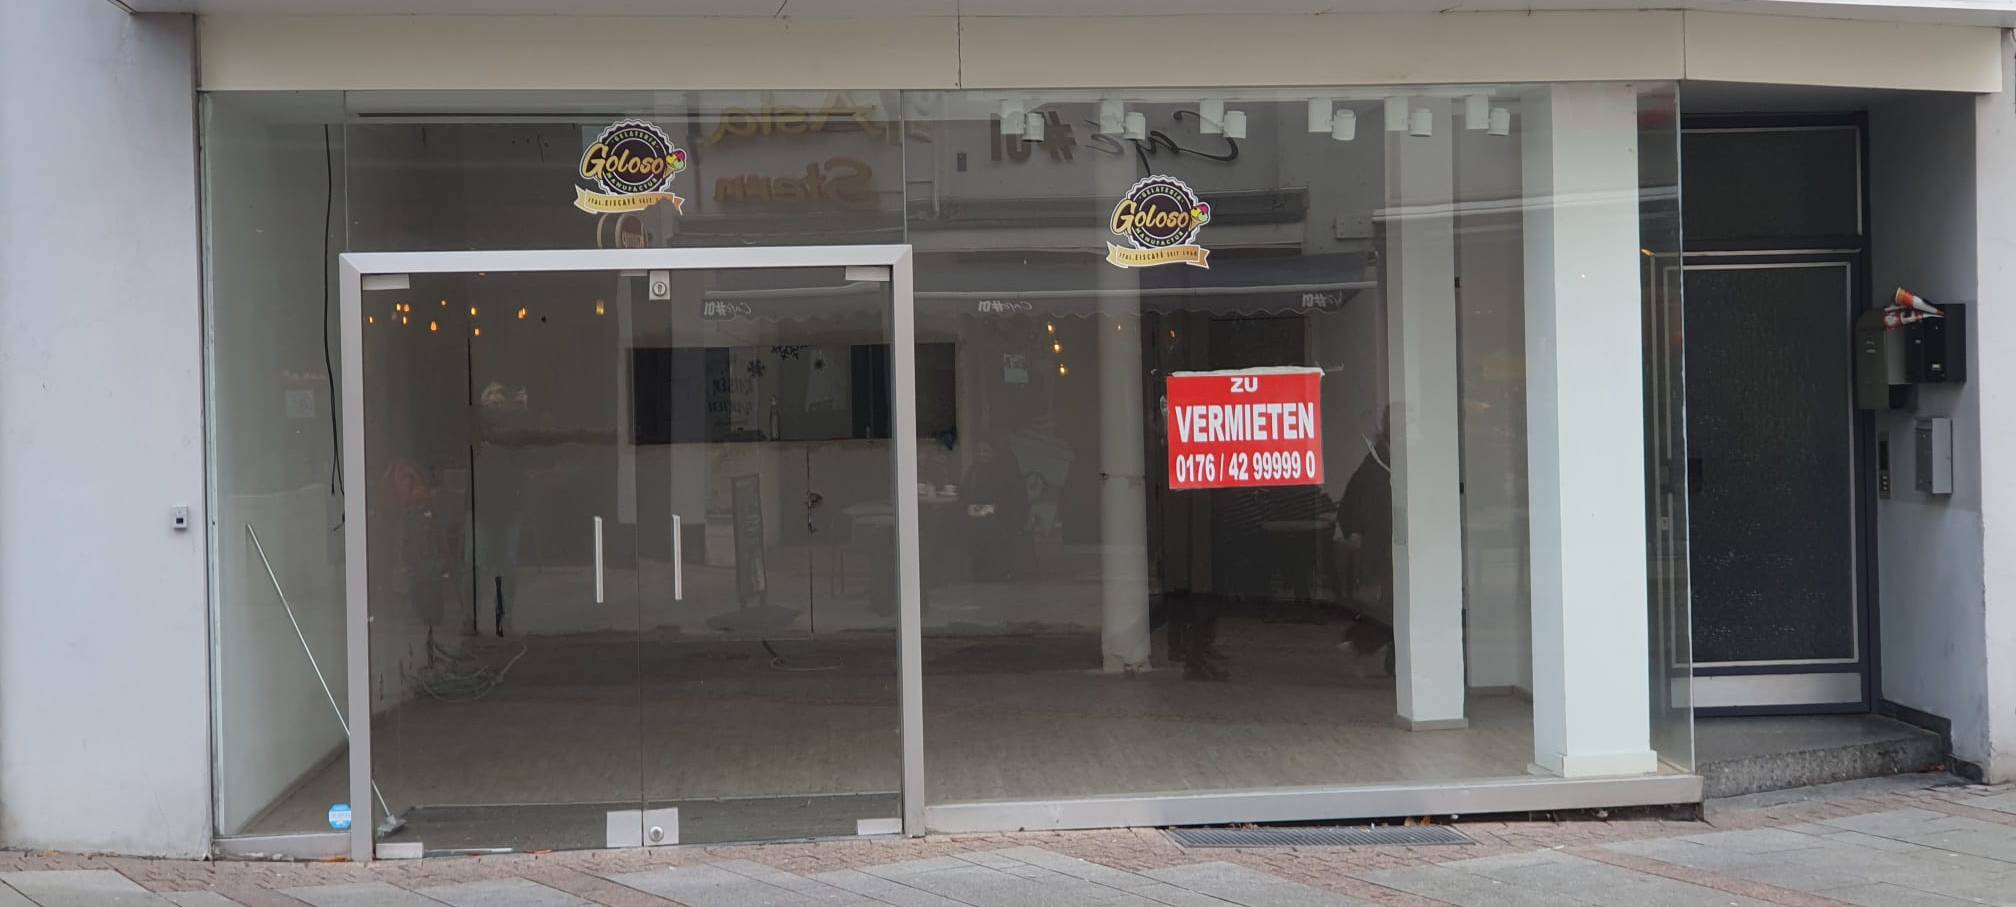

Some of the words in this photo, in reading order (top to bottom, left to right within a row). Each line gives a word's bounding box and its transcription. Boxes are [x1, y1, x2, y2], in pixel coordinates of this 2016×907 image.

[614, 130, 657, 147] GELATERIA
[582, 143, 664, 178] Goloso
[1141, 186, 1182, 201] GELATERIA
[1112, 199, 1189, 234] Goloso
[1230, 376, 1258, 393] ZU
[1175, 402, 1314, 443] VERMIETEN
[1176, 452, 1216, 482] 0176
[1219, 452, 1225, 482] /
[1228, 452, 1249, 480] 42
[1253, 451, 1301, 480] 99999
[1306, 450, 1315, 479] 0
